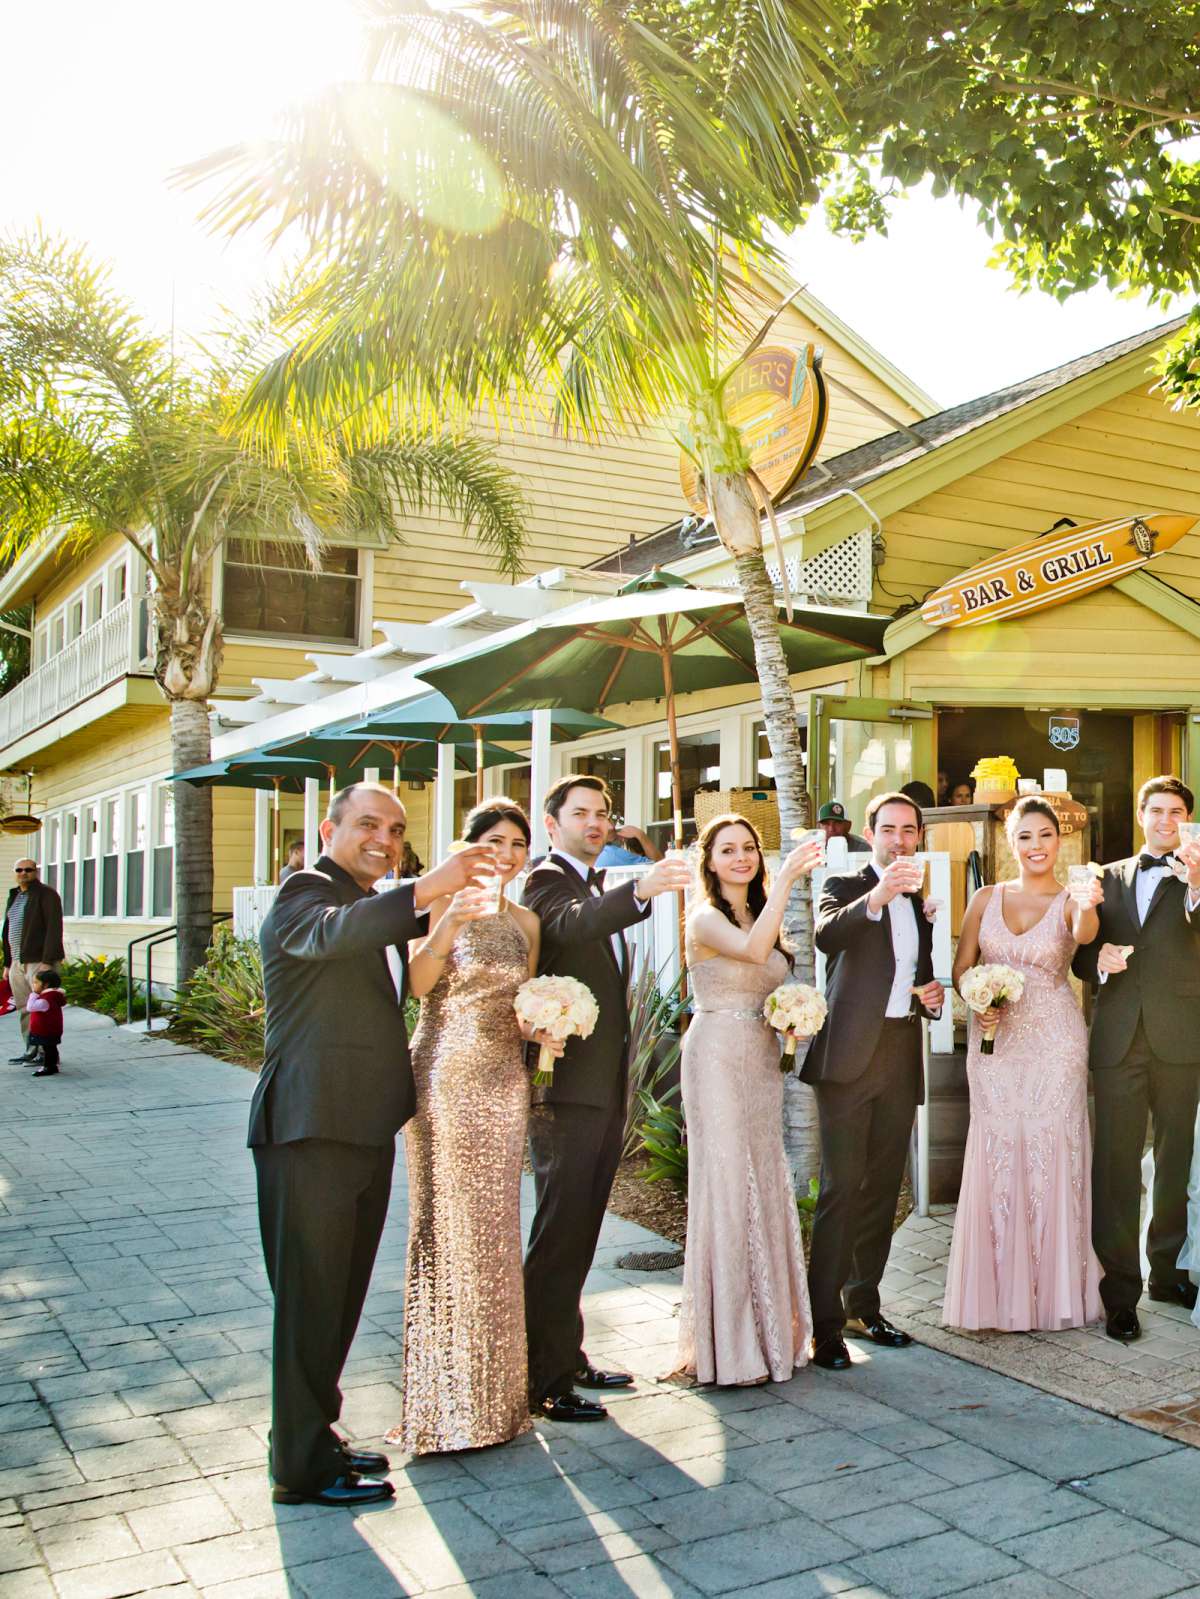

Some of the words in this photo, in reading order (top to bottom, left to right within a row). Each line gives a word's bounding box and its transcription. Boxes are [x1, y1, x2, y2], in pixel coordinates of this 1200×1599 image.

[962, 578, 1012, 611] BAR
[1017, 570, 1035, 592] &
[1041, 543, 1112, 582] GRILL
[1051, 726, 1079, 744] 805
[1073, 812, 1087, 822] TO
